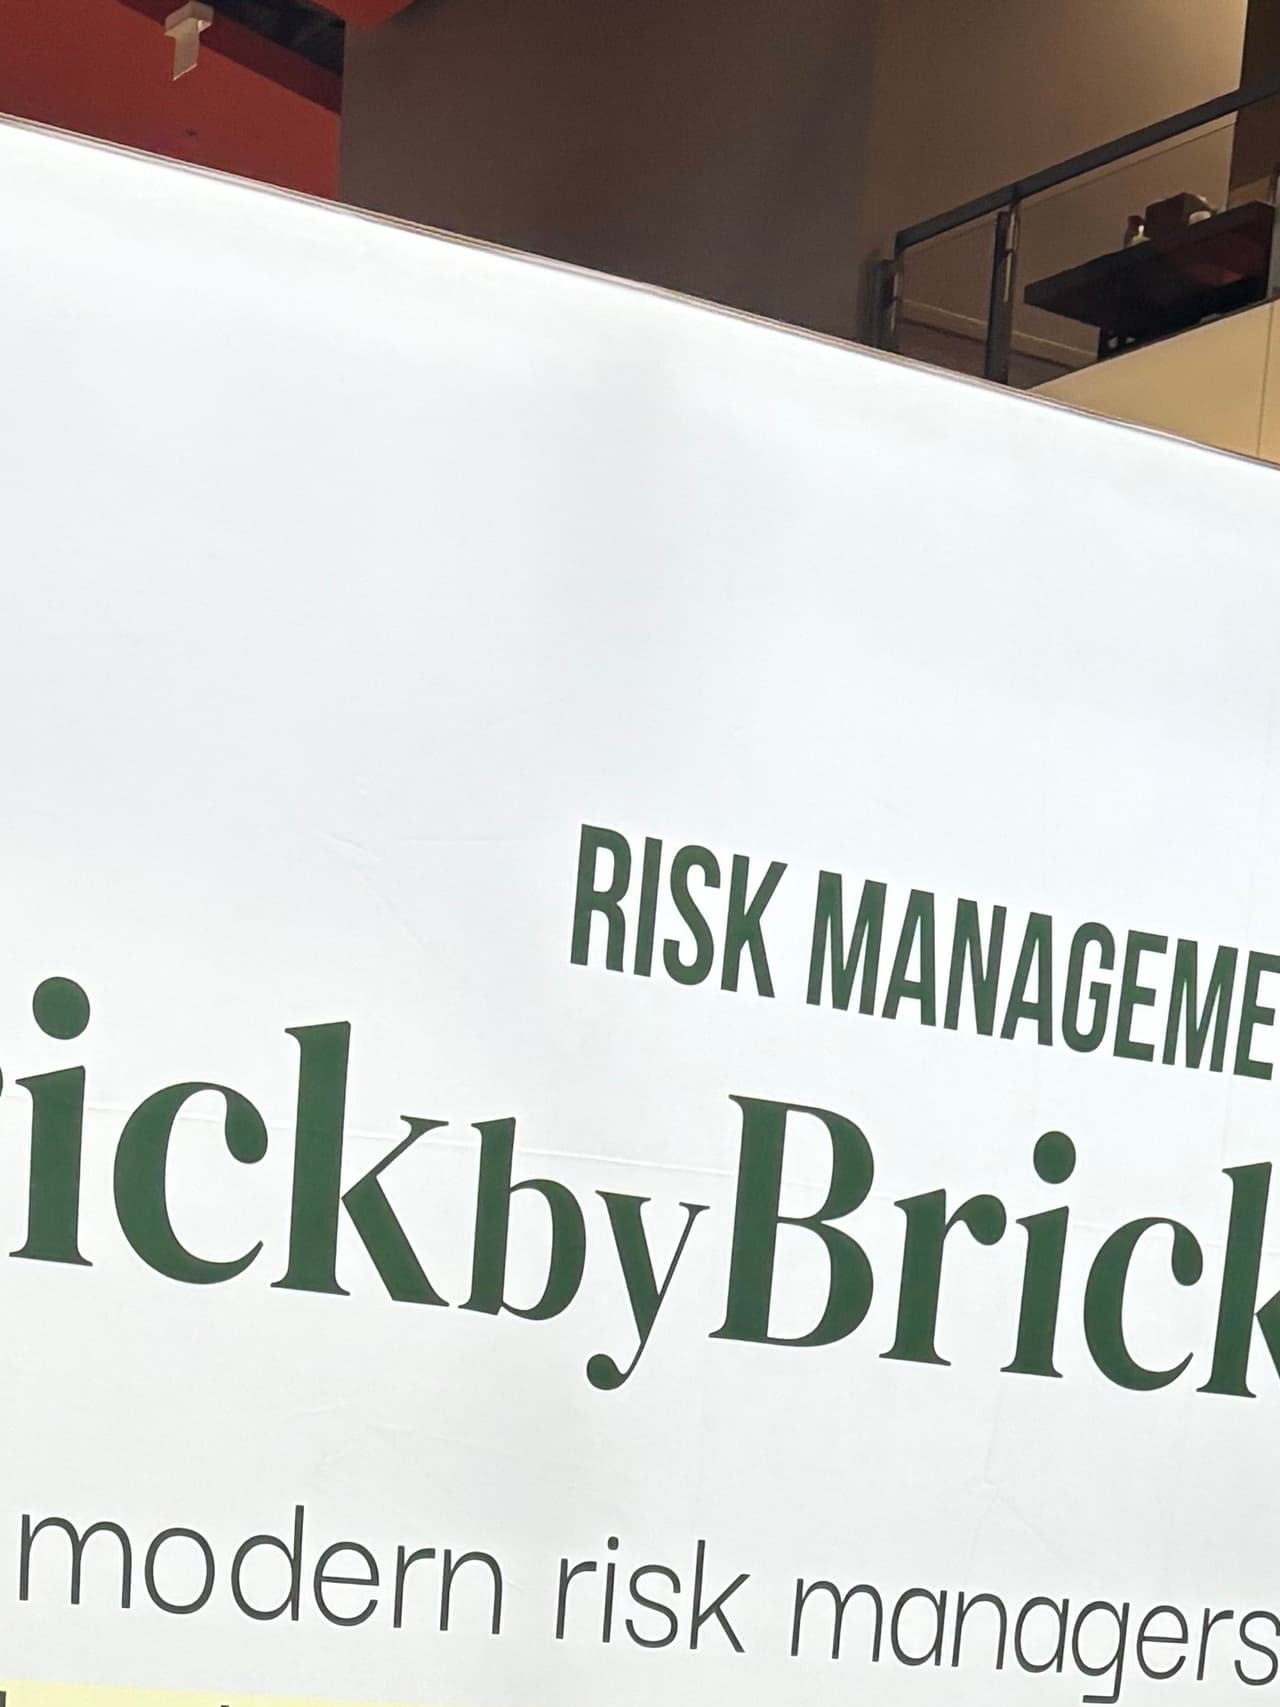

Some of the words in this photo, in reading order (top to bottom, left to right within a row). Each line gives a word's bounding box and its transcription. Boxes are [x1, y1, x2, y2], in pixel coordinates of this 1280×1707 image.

[570, 823, 788, 999] RISK
[19, 1504, 503, 1635] modern
[555, 1539, 751, 1653] risk
